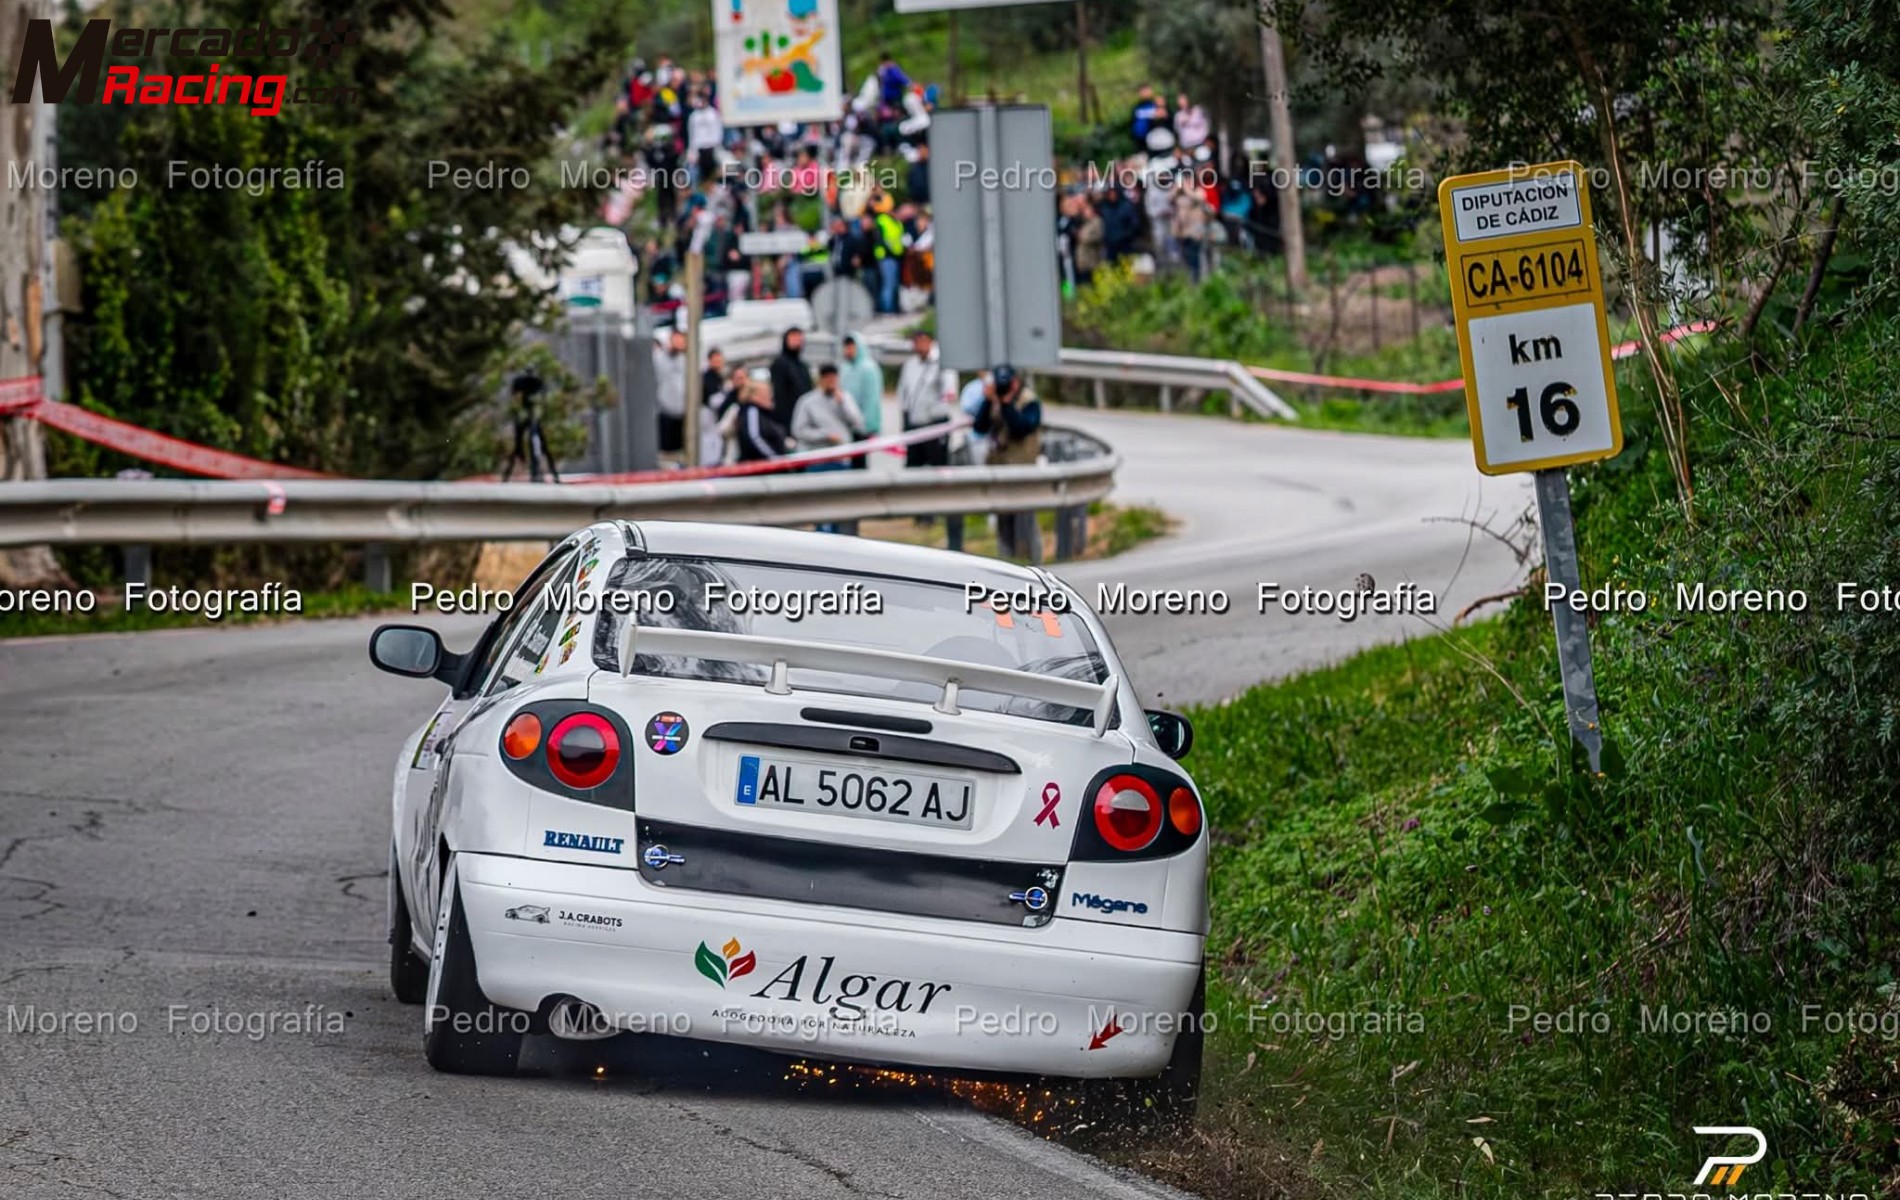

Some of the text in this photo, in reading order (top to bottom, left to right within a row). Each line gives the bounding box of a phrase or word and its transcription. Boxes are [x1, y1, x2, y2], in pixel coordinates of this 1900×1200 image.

[1462, 181, 1569, 212] DIPUTACIÓN
[1477, 206, 1559, 230] DE CÁDIZ
[1467, 248, 1584, 298] CA-6104
[1509, 333, 1562, 365] km
[1506, 381, 1581, 443] 16
[743, 784, 752, 796] E
[759, 764, 970, 822] AL 5062 AJ
[543, 830, 625, 854] RENAULT
[750, 955, 952, 1021] Algar
